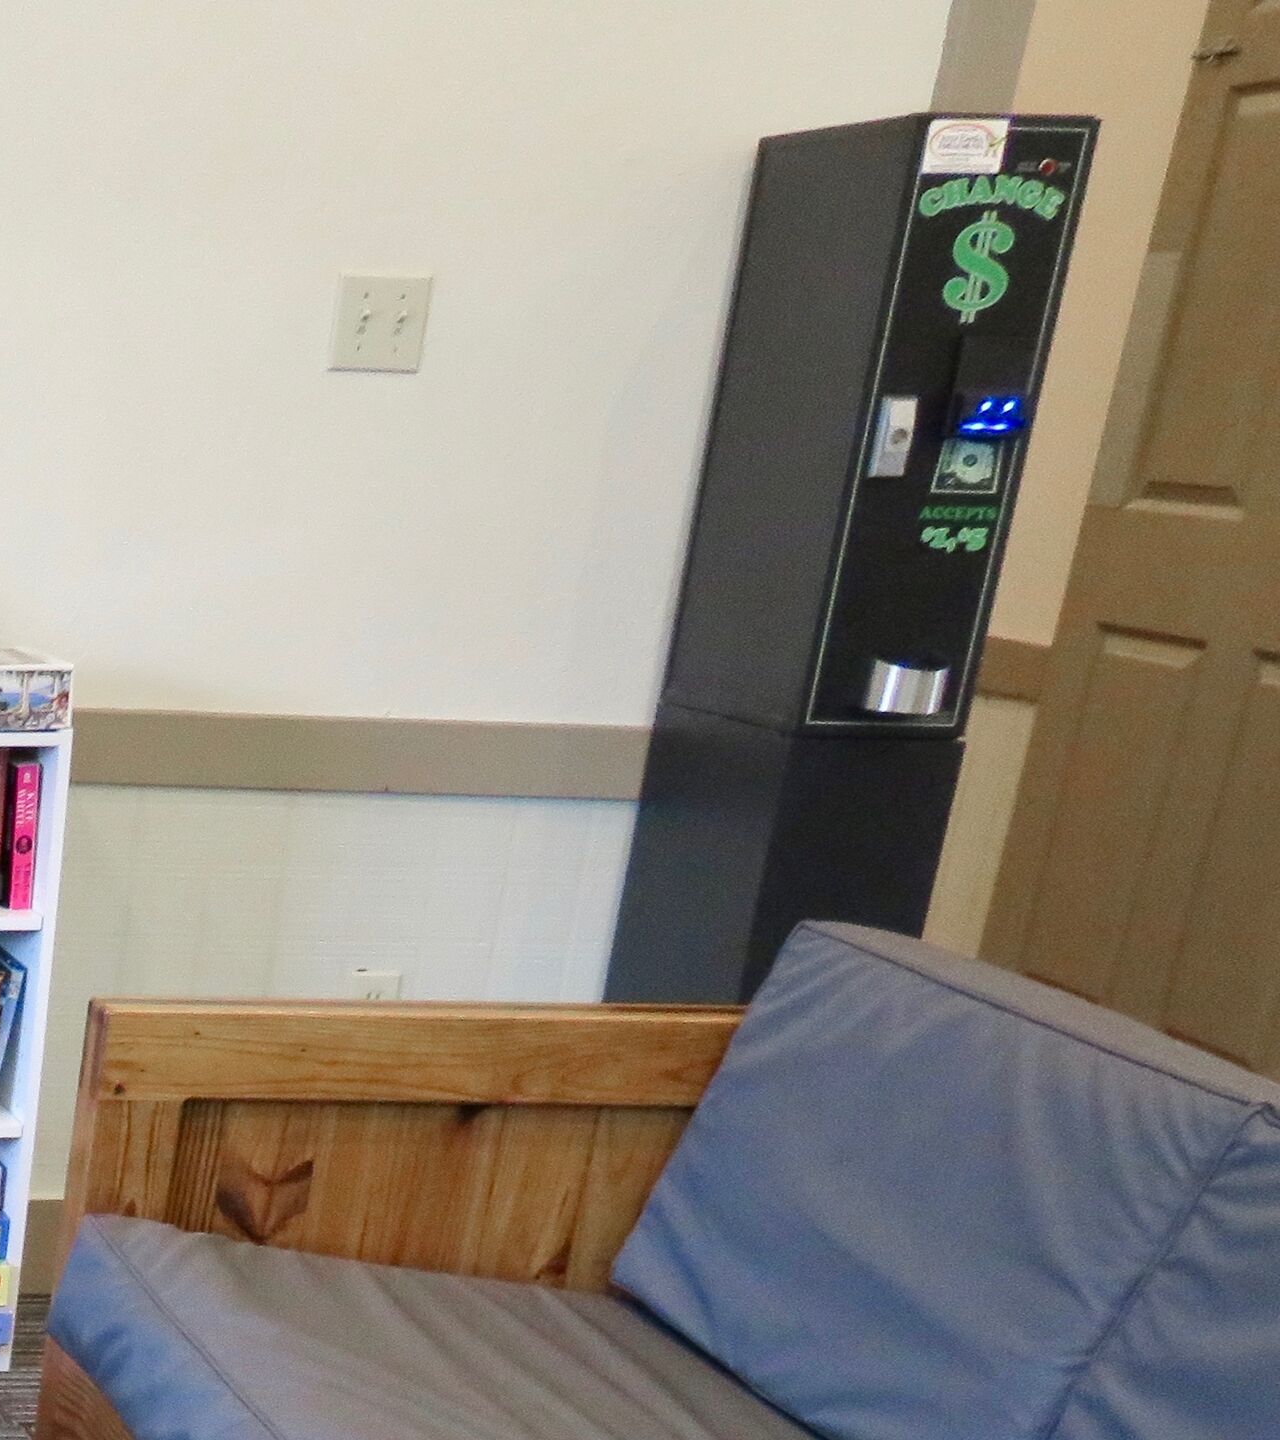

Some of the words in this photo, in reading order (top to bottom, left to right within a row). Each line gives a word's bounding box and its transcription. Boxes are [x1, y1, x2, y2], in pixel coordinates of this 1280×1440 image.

[919, 174, 1065, 221] CHANGE
[919, 506, 998, 520] ACCEPTS
[25, 791, 36, 822] KATE
